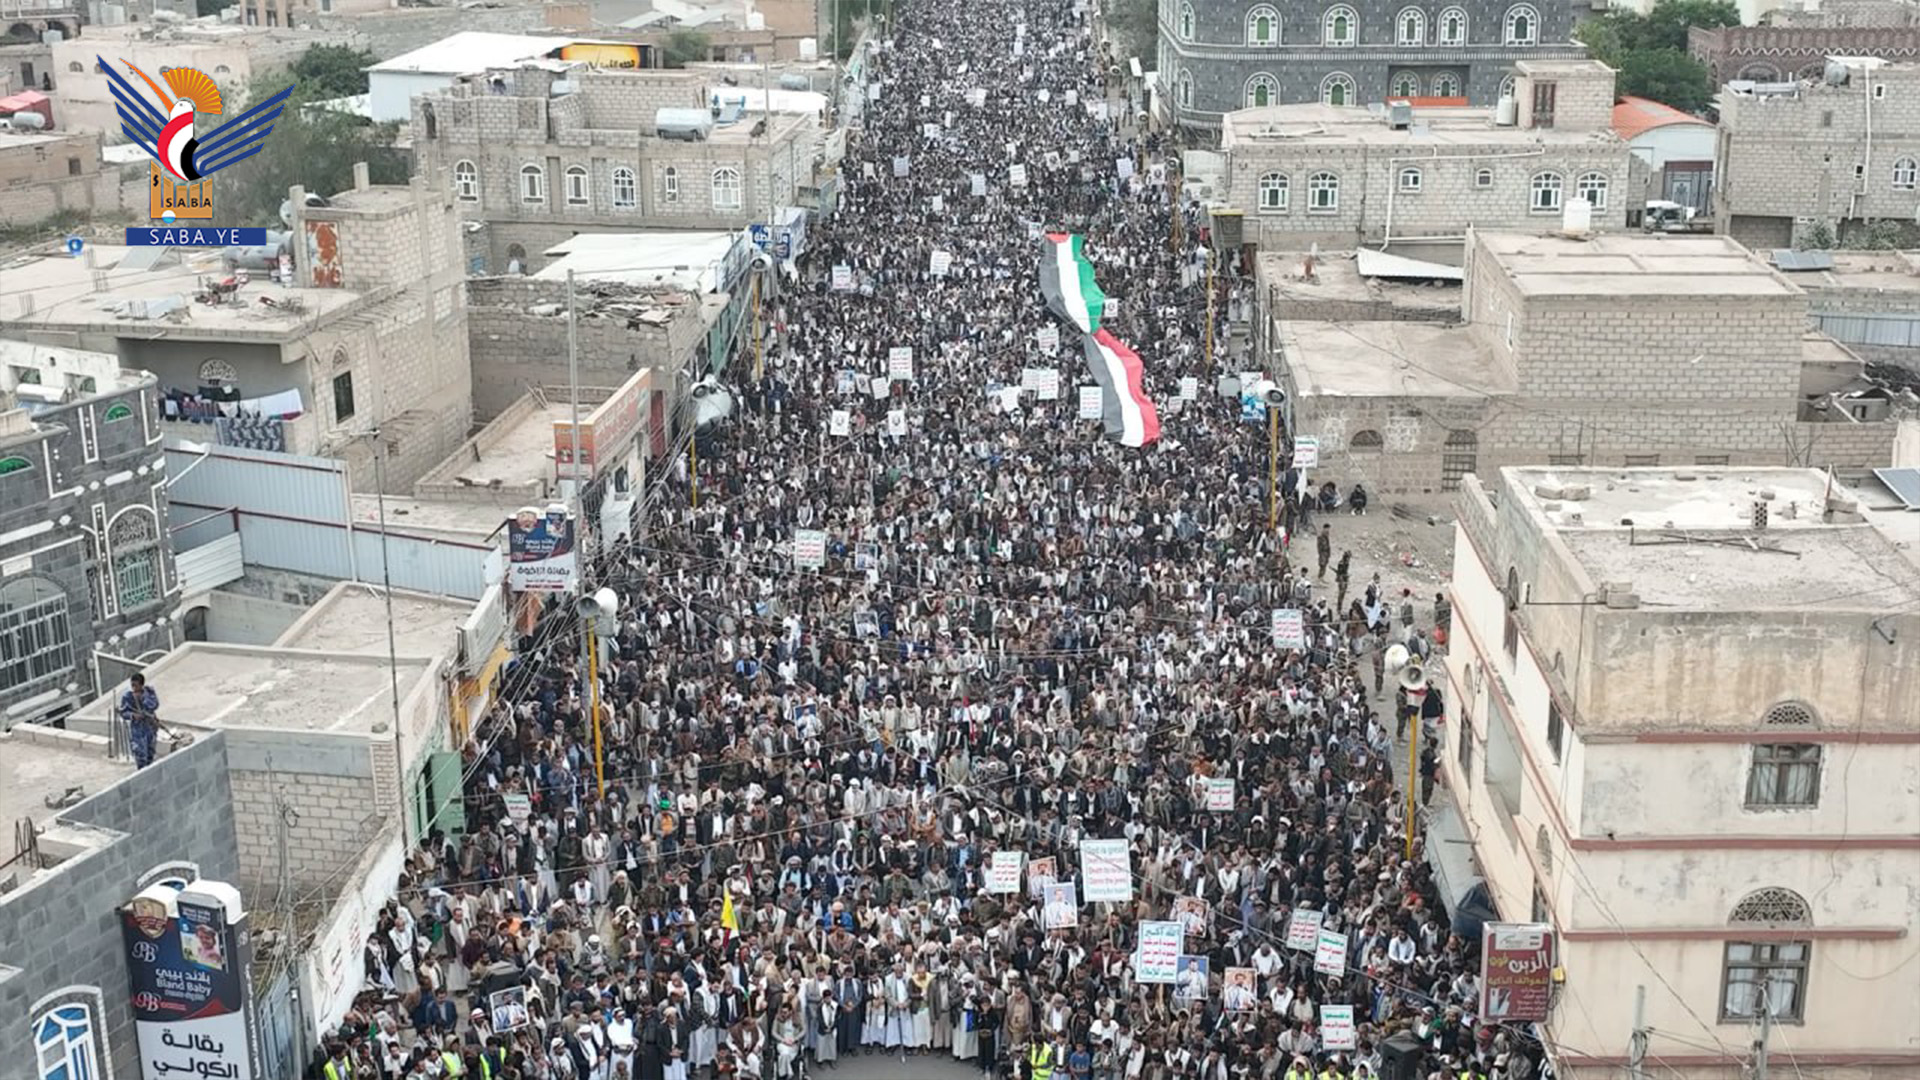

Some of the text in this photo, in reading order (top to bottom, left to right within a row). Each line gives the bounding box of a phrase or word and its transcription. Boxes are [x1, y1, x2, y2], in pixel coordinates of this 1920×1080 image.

[156, 979, 186, 991] Bland
[186, 982, 213, 996] Baby
[161, 1028, 224, 1058] بقالة
[152, 1056, 239, 1079] الكولي
